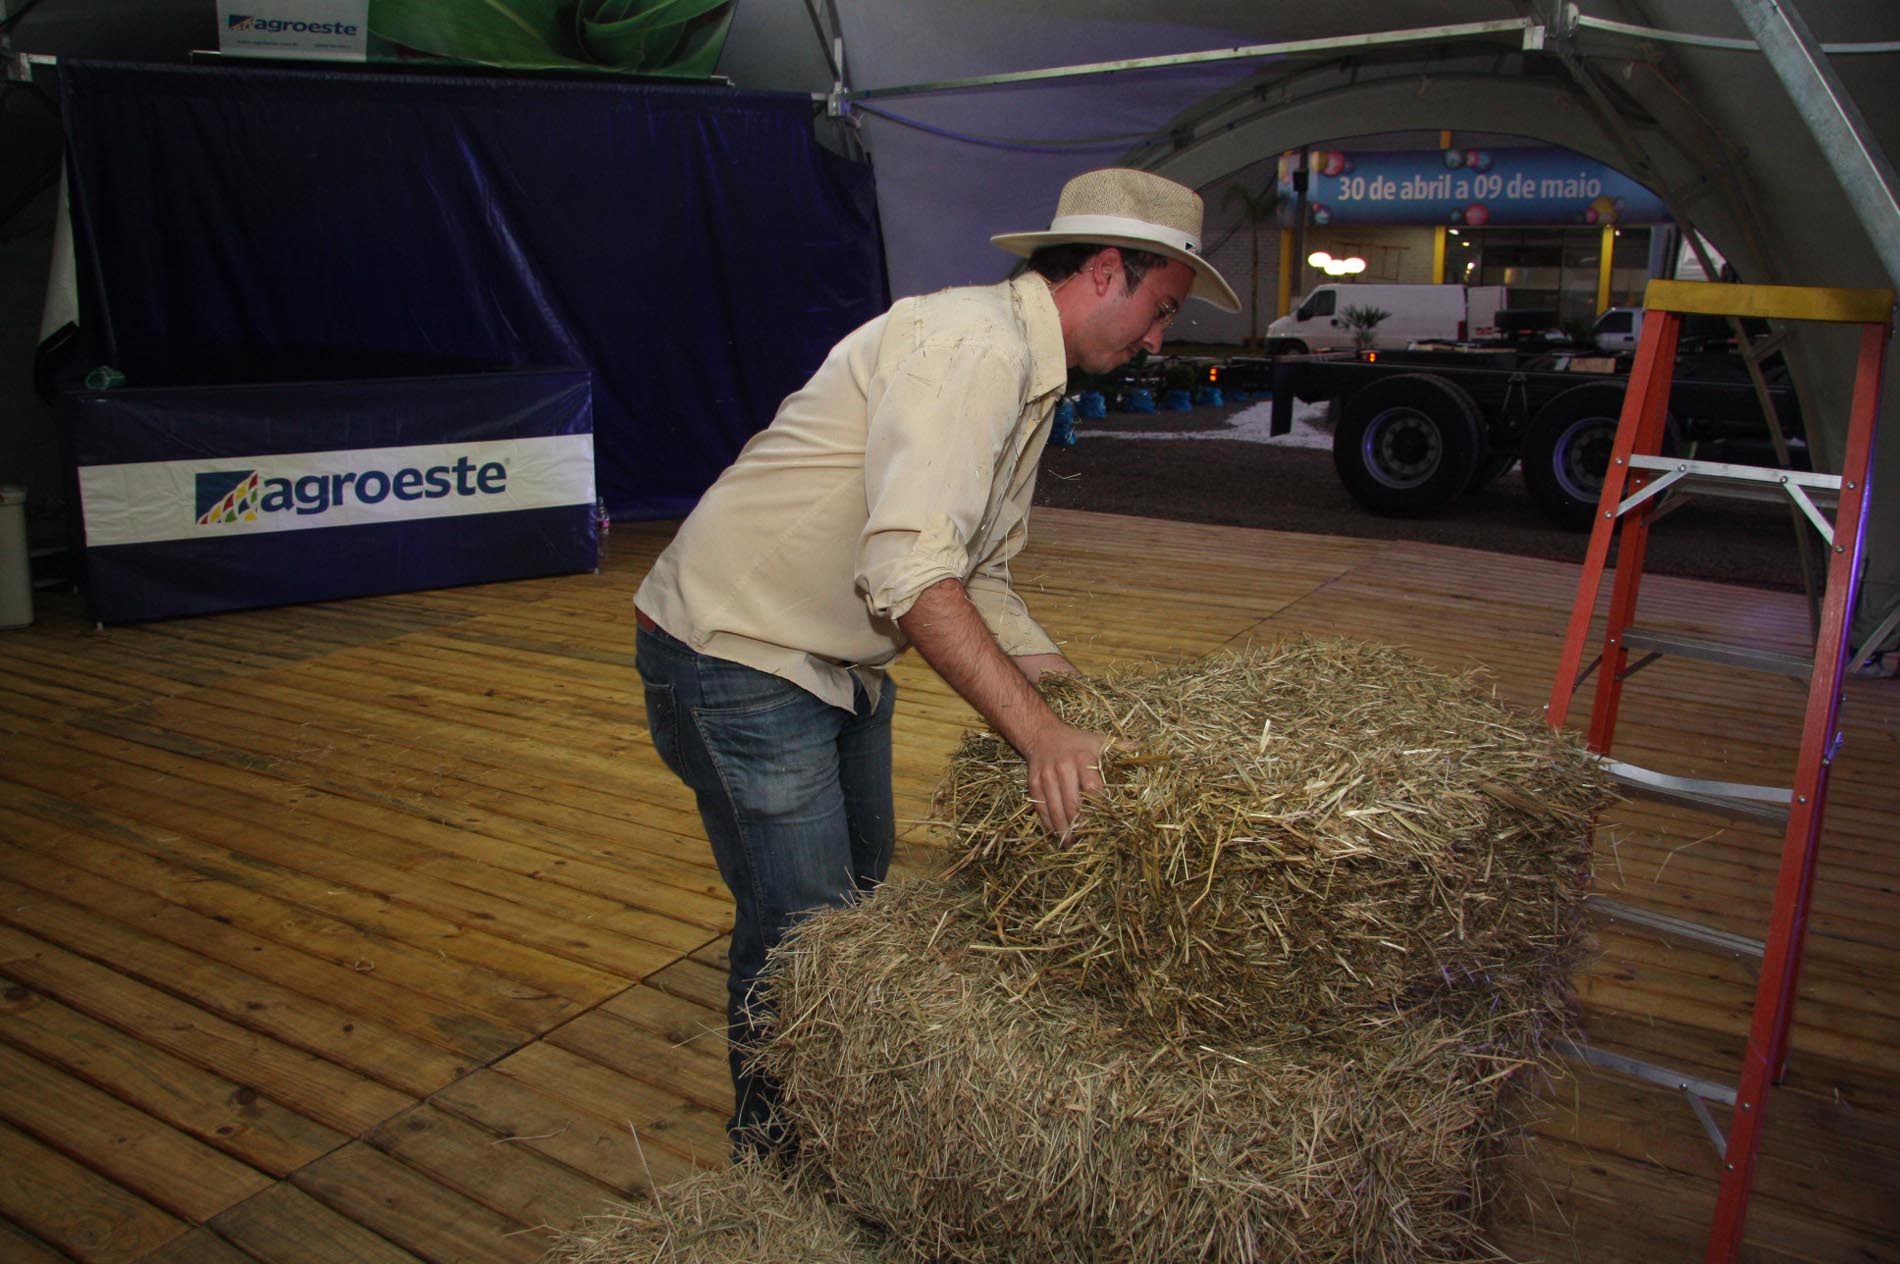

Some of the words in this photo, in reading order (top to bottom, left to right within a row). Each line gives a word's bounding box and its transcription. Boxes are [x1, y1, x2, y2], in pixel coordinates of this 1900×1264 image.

[254, 18, 358, 36] agroeste
[1338, 177, 1365, 200] 30
[1369, 176, 1396, 200] de
[1402, 175, 1450, 200] abril
[1455, 182, 1469, 199] a
[1474, 175, 1502, 199] 09
[1507, 172, 1536, 199] de
[1541, 172, 1601, 198] maio
[260, 455, 509, 515] agroeste
